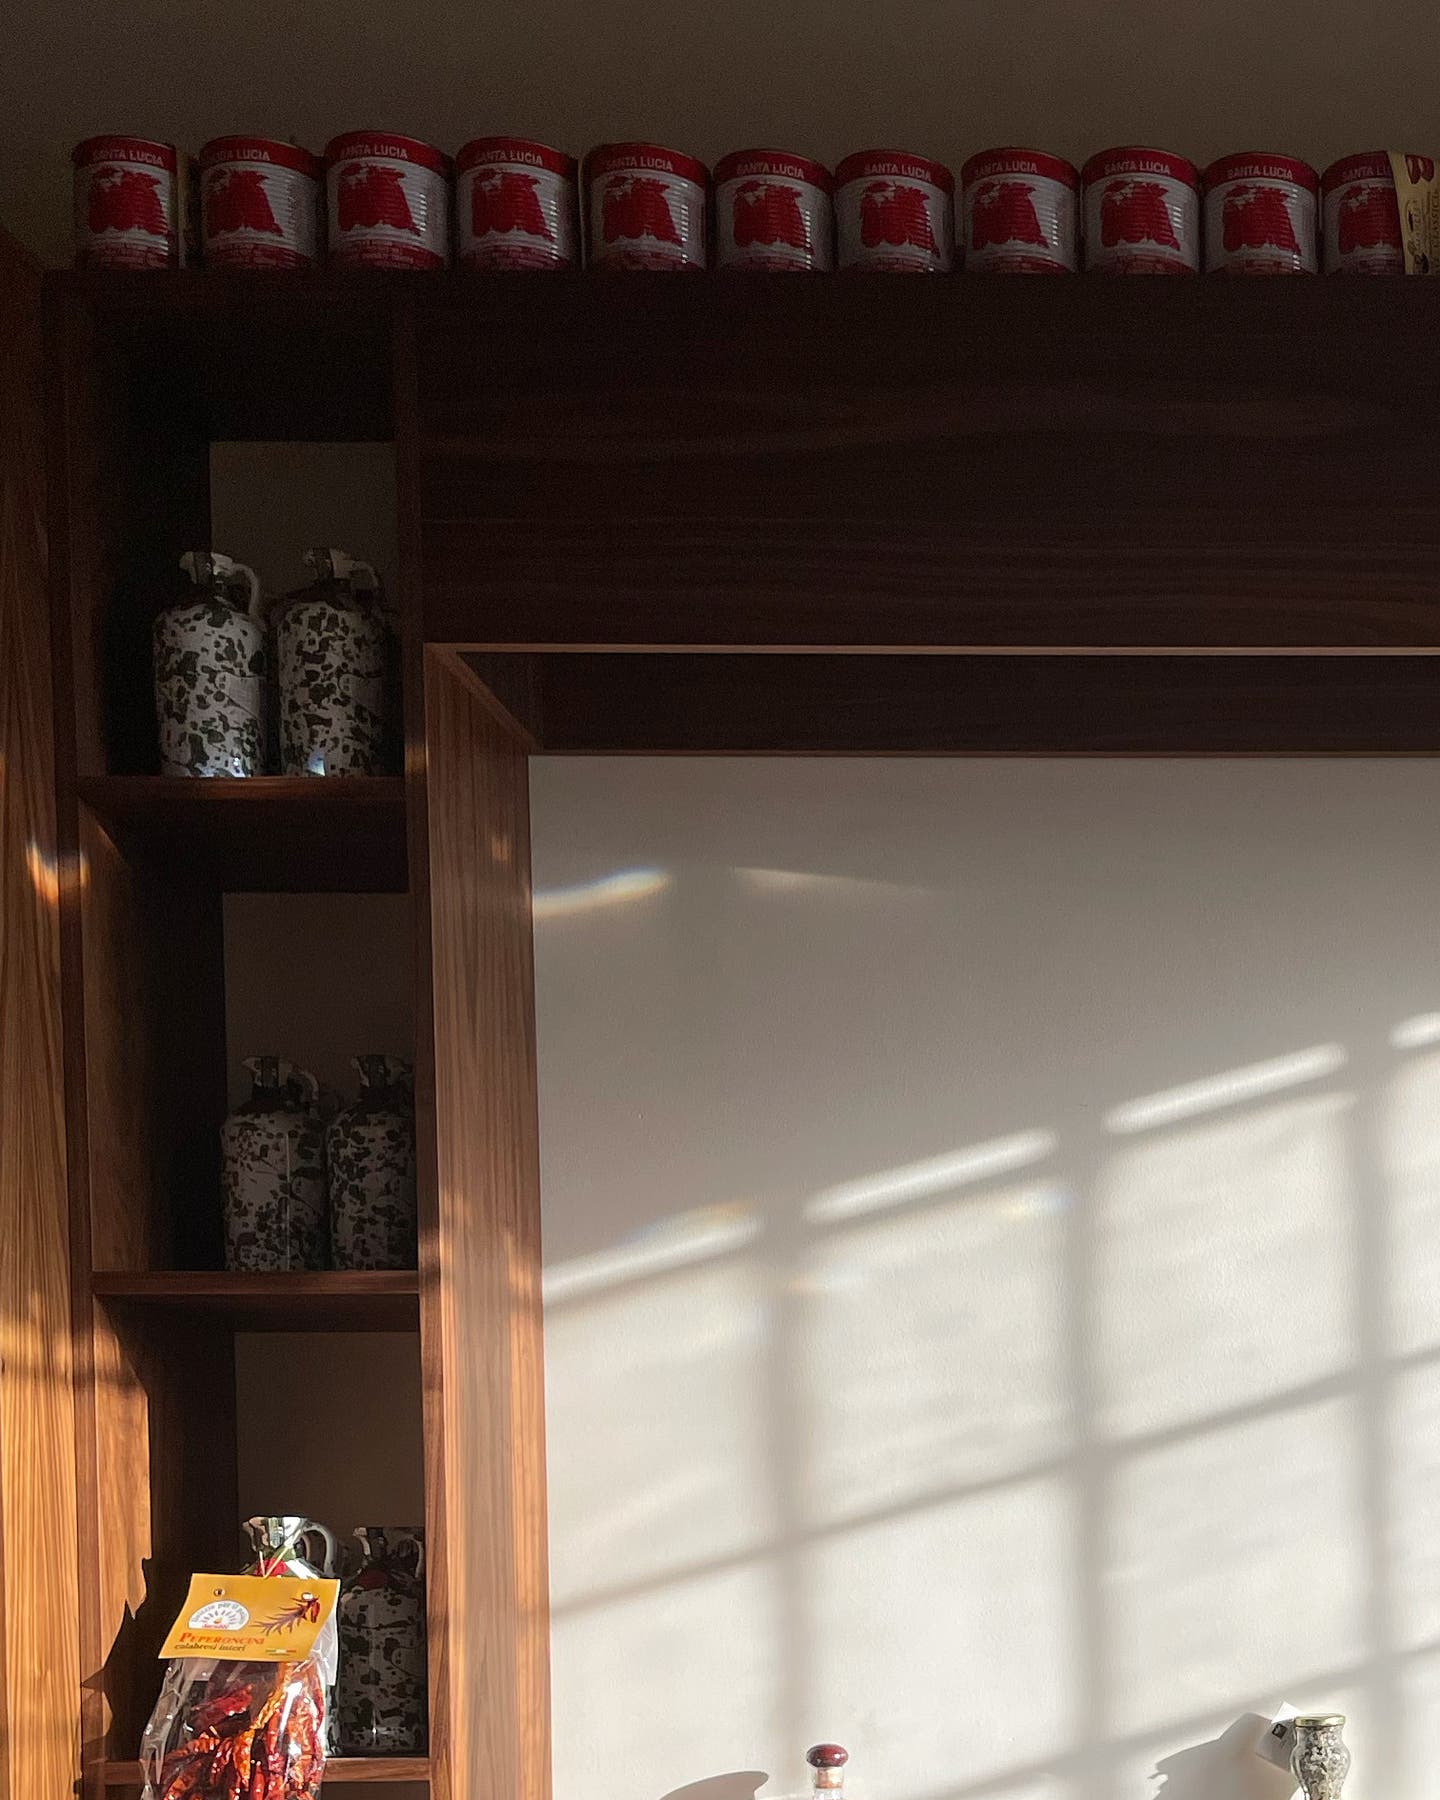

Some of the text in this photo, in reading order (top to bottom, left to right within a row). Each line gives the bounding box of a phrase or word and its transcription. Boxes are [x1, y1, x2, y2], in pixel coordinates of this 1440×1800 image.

[130, 151, 164, 167] LUCIA
[237, 150, 270, 161] LUCIA
[374, 146, 408, 160] LUCIA
[510, 151, 543, 166] LUCIA
[641, 157, 673, 172] LUCIA
[772, 163, 804, 179] LUCIA
[1005, 162, 1037, 174] LUCIA
[1104, 161, 1170, 175] SANTA LUCIA
[864, 163, 931, 181] SANTA LUCIA
[1229, 167, 1293, 180] SANTA LUCIA
